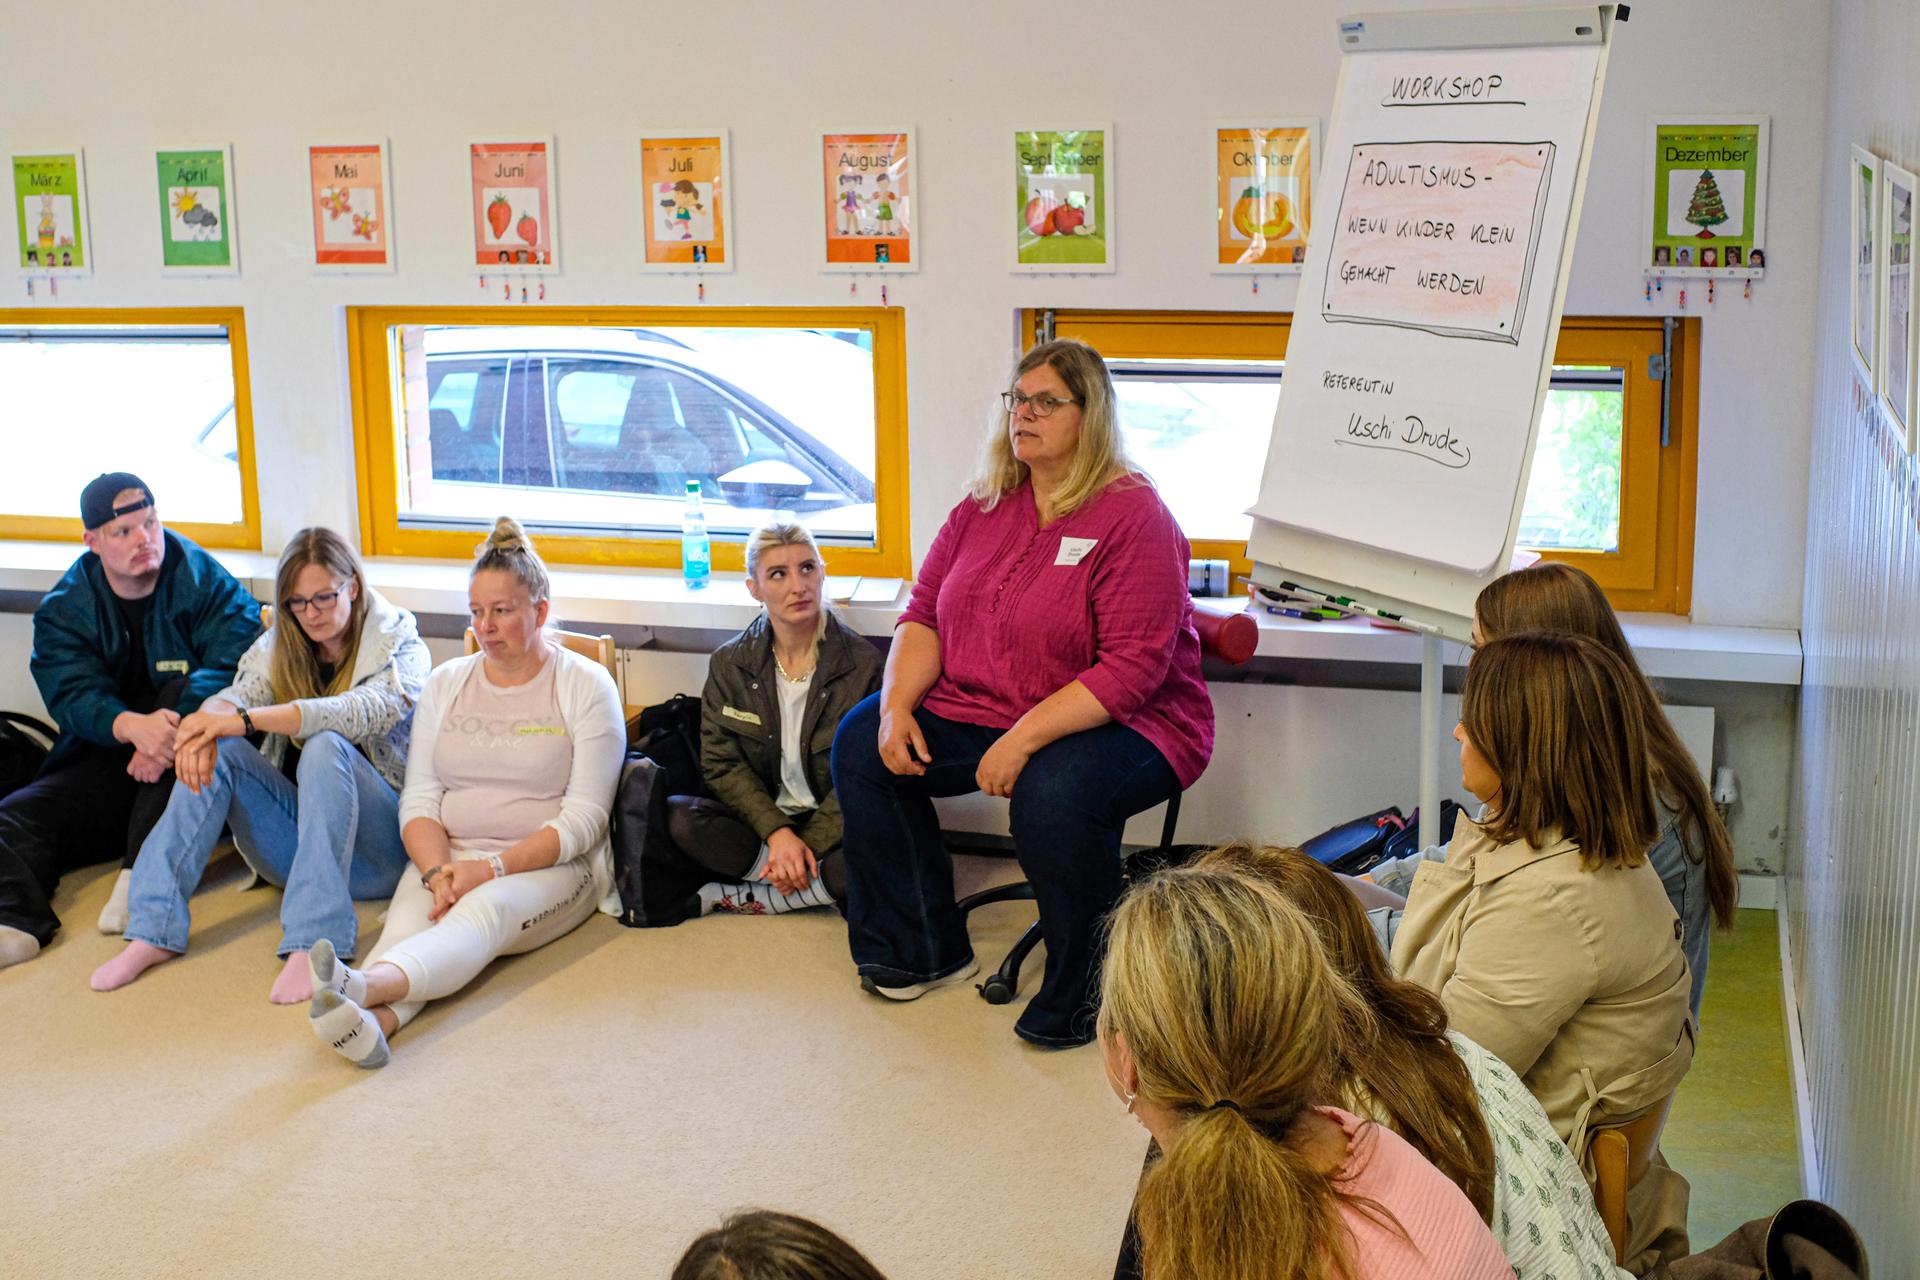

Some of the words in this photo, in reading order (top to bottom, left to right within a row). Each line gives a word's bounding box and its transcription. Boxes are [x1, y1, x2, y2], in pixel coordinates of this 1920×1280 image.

[1391, 74, 1503, 99] WORKSHOP
[838, 152, 893, 172] August
[1020, 151, 1101, 169] Septber
[1232, 151, 1295, 167] Okber
[1665, 146, 1749, 162] Dezember
[334, 163, 359, 179] Mai
[494, 162, 525, 178] Juni
[668, 157, 694, 172] Juli
[30, 173, 62, 187] März
[176, 167, 208, 186] April
[1348, 215, 1388, 235] WENN
[1340, 260, 1396, 286] GEMACHT
[1416, 269, 1486, 296] WERDEN
[1348, 412, 1395, 440] Uschi
[1401, 415, 1464, 458] Drude
